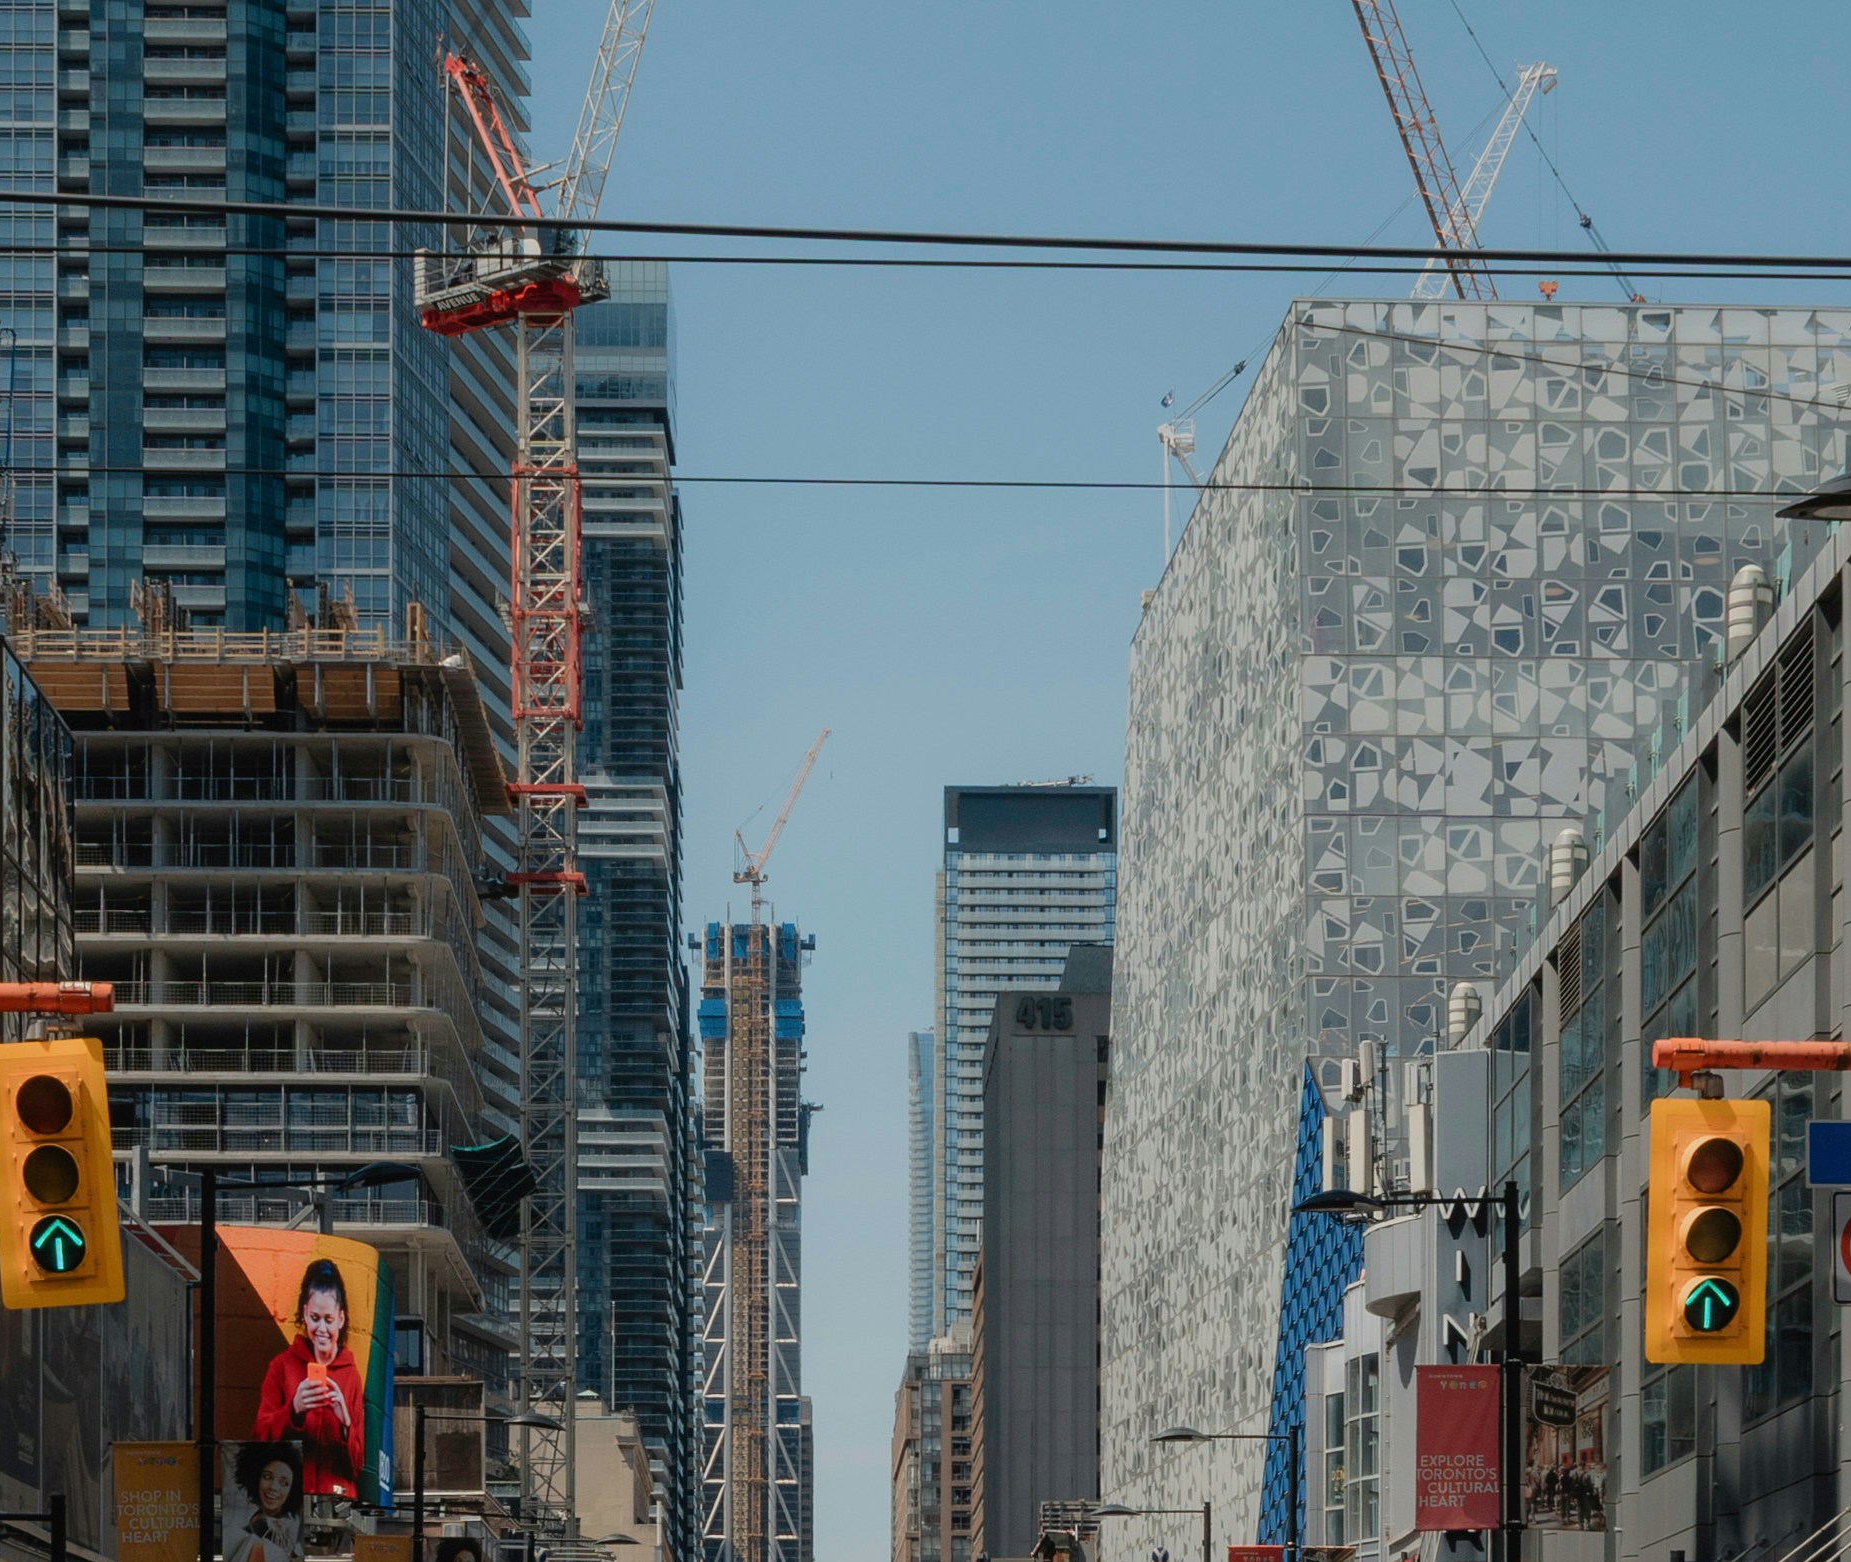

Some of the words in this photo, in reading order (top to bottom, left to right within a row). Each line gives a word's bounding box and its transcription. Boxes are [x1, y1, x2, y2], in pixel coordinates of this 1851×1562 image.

[437, 291, 481, 311] AVENUE
[1016, 996, 1073, 1030] 415
[1421, 1455, 1484, 1467] EXPLORE
[1416, 1468, 1497, 1481] TORONTO'S
[1428, 1482, 1500, 1494] CULTURAL
[121, 1490, 162, 1503] SHOP
[165, 1490, 181, 1502] IN
[1418, 1495, 1466, 1508] HEART
[117, 1504, 199, 1517] TORONTO'S
[129, 1517, 200, 1530] CULTURAL
[122, 1530, 169, 1544] HEART
